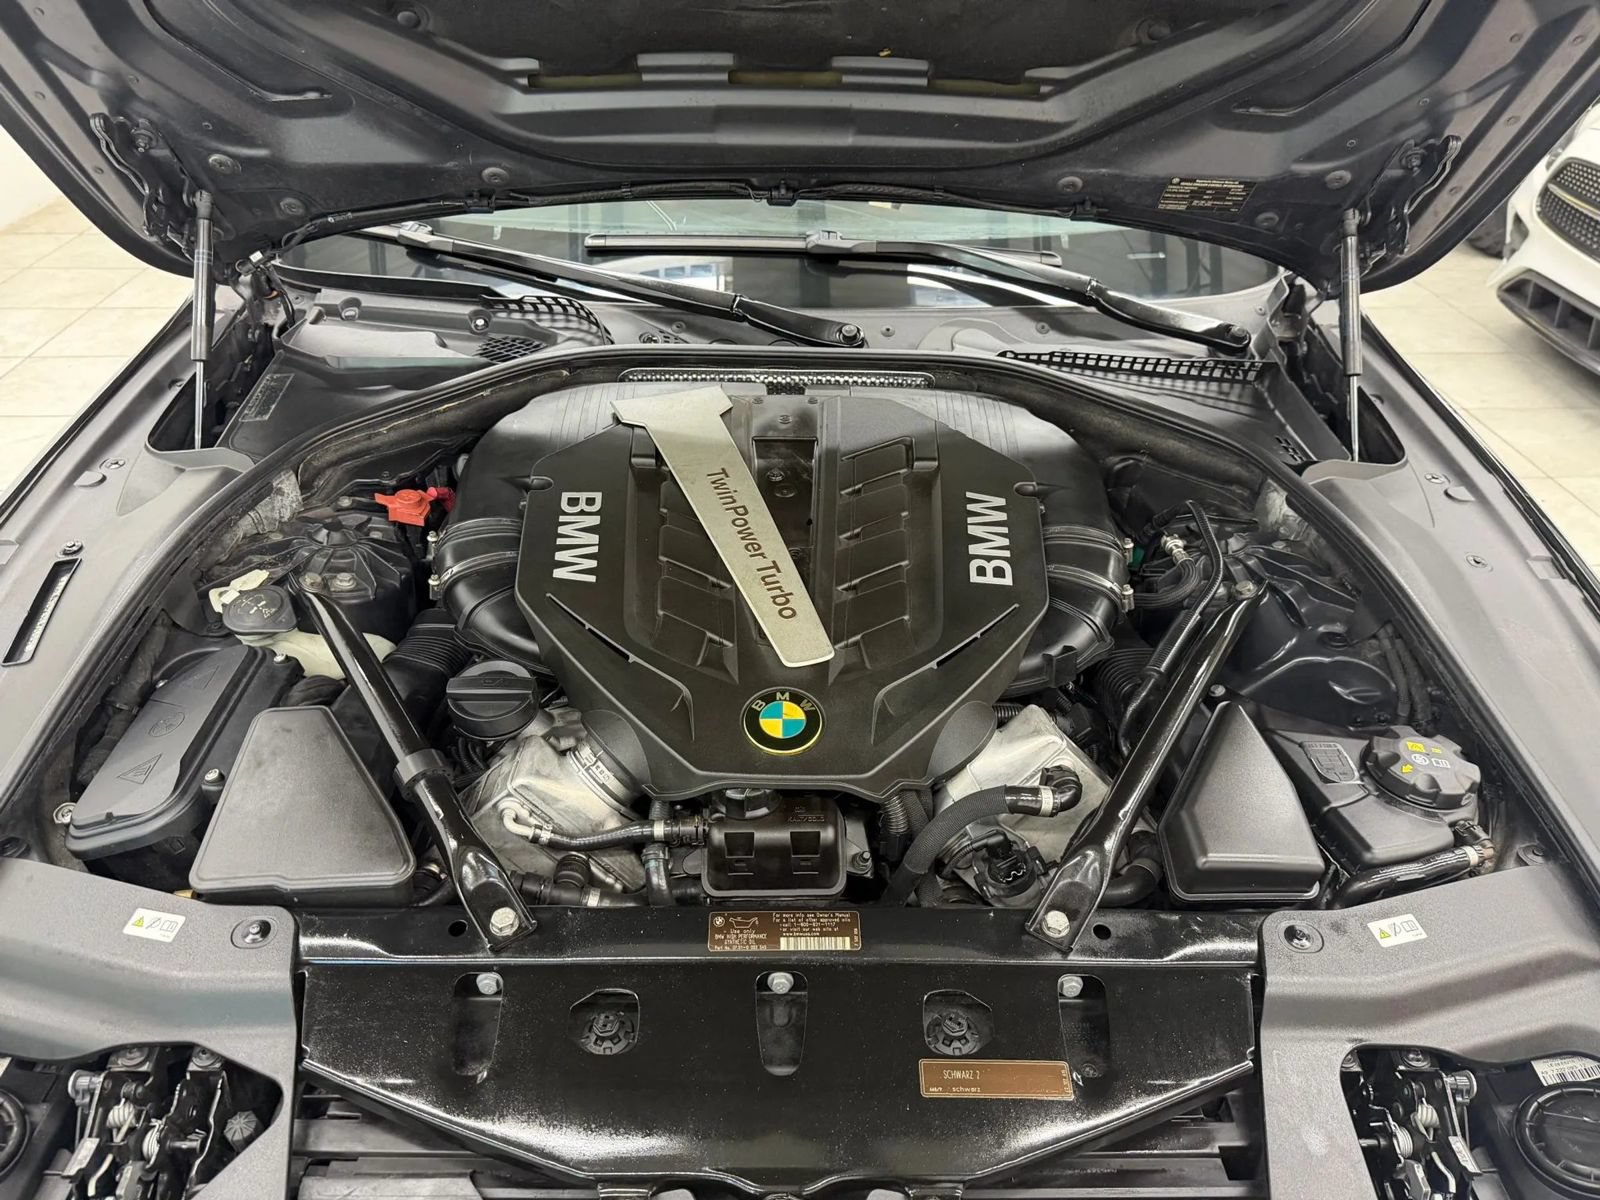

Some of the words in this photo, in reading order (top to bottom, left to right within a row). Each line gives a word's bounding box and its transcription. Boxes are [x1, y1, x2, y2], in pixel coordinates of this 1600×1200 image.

[552, 491, 602, 583] BMW
[706, 467, 767, 561] TwinPower
[756, 560, 798, 620] Turbo
[965, 491, 1014, 586] BMW
[751, 691, 816, 712] BMW
[943, 1069, 973, 1079] SCHWARZ
